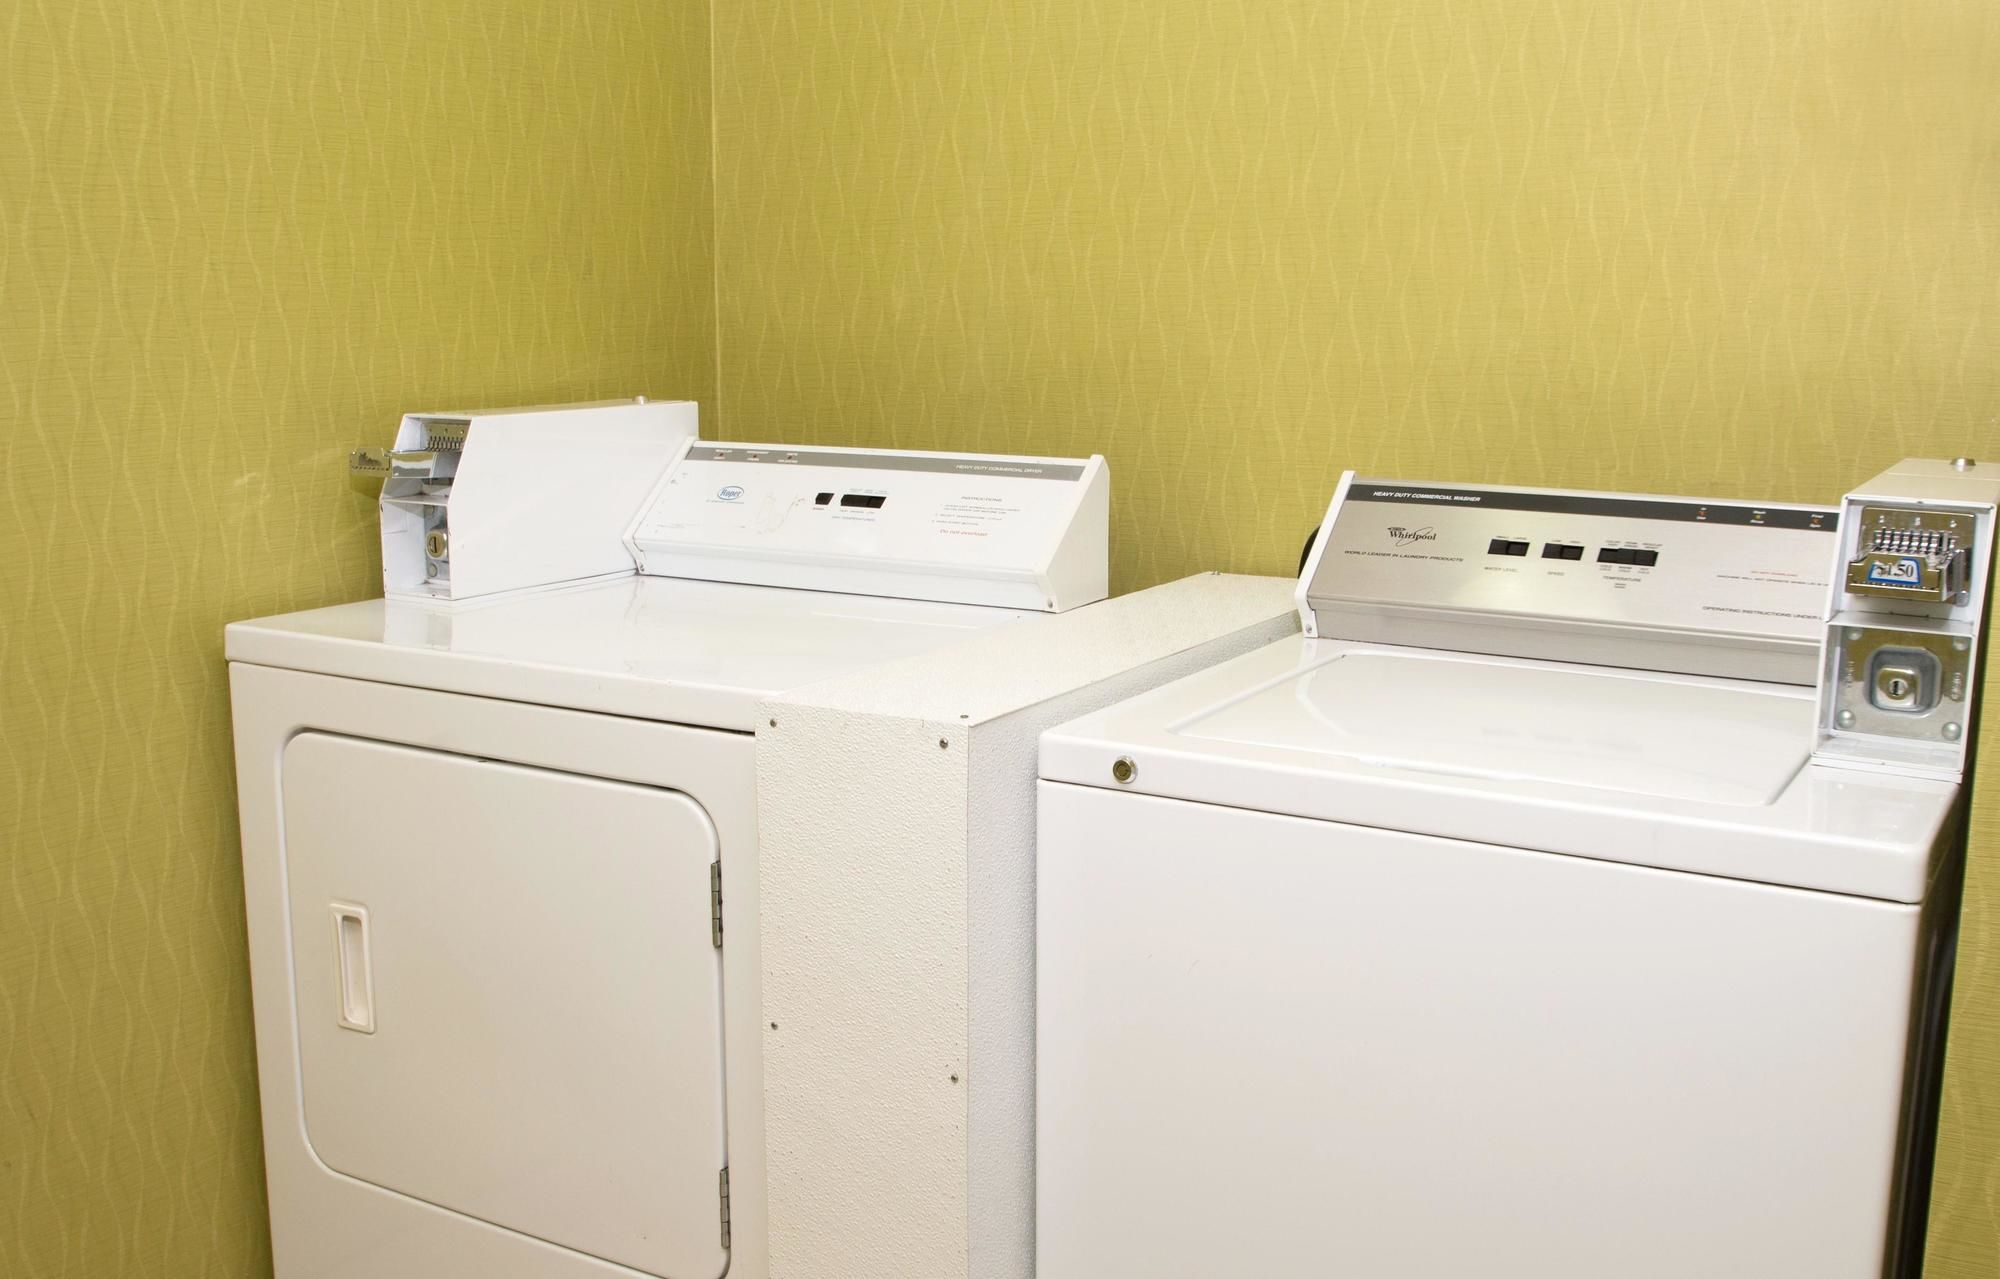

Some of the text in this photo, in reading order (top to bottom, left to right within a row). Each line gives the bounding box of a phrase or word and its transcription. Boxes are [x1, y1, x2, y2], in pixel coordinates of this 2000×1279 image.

[720, 487, 742, 498] Roper
[1389, 530, 1437, 541] Whirlpool
[1742, 609, 1792, 618] INSTRUCTIONS
